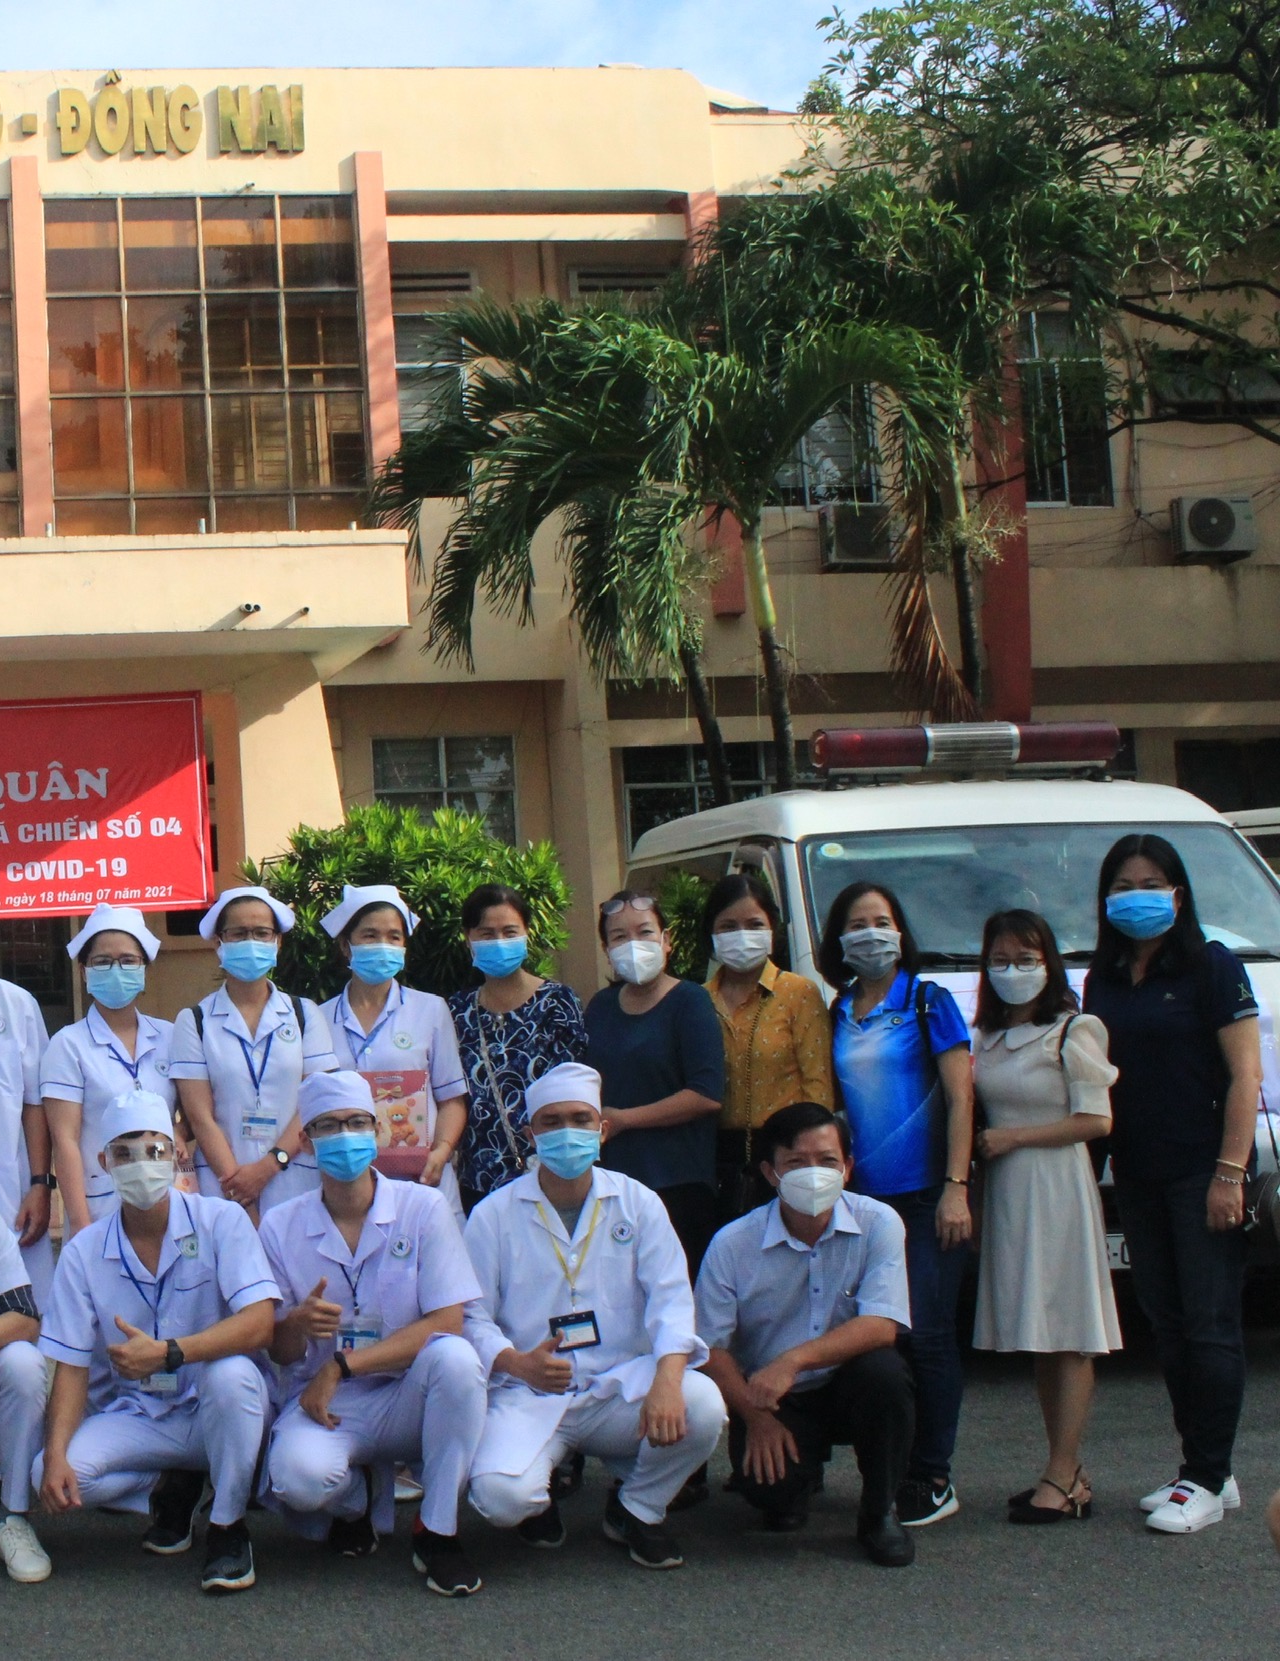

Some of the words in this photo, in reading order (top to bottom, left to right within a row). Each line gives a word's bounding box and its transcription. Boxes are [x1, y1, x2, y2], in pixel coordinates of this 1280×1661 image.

[56, 68, 203, 155] ĐỒNG
[217, 84, 306, 153] NAI
[17, 815, 98, 843] CHIẾN
[106, 812, 142, 839] SỐ
[150, 816, 183, 837] 04
[6, 857, 128, 882] COVID-19
[5, 893, 36, 907] ngày
[40, 891, 54, 903] 18
[57, 889, 93, 905] tháng
[96, 888, 111, 900] 07
[114, 887, 141, 900] năm
[144, 885, 173, 898] 2021
